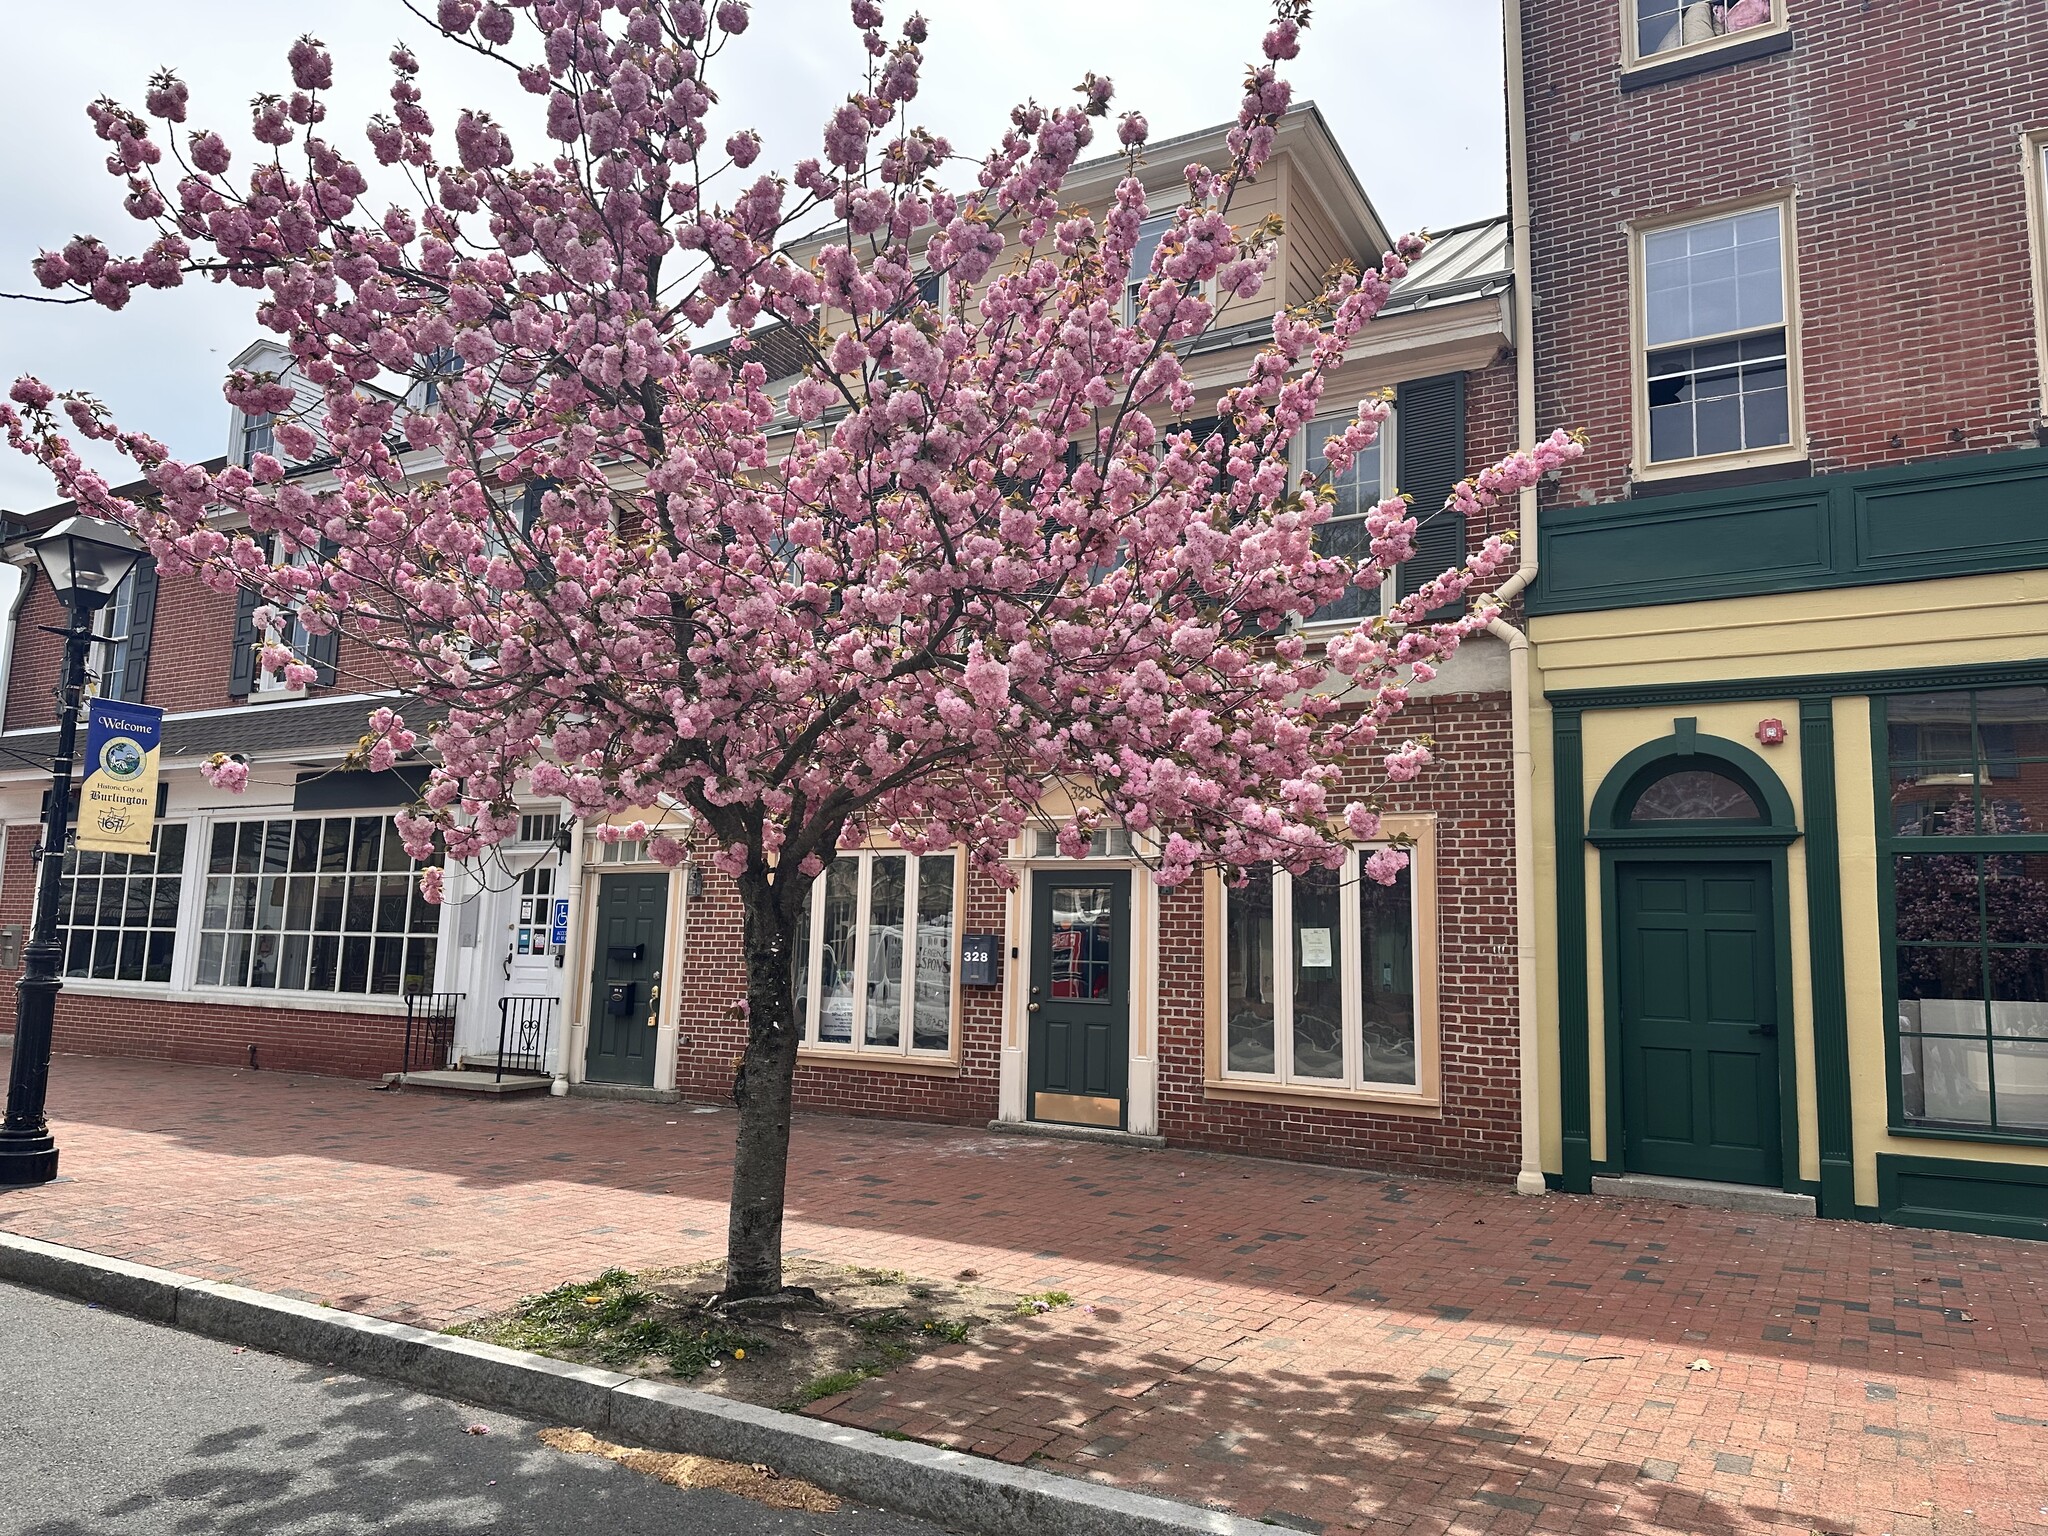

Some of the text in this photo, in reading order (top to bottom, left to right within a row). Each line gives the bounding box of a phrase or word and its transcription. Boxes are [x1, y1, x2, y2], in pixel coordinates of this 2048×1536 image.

[98, 716, 152, 734] Welcome
[90, 790, 148, 805] Burlington
[1071, 786, 1092, 800] 328
[102, 818, 124, 832] 1677
[964, 952, 988, 962] 328
